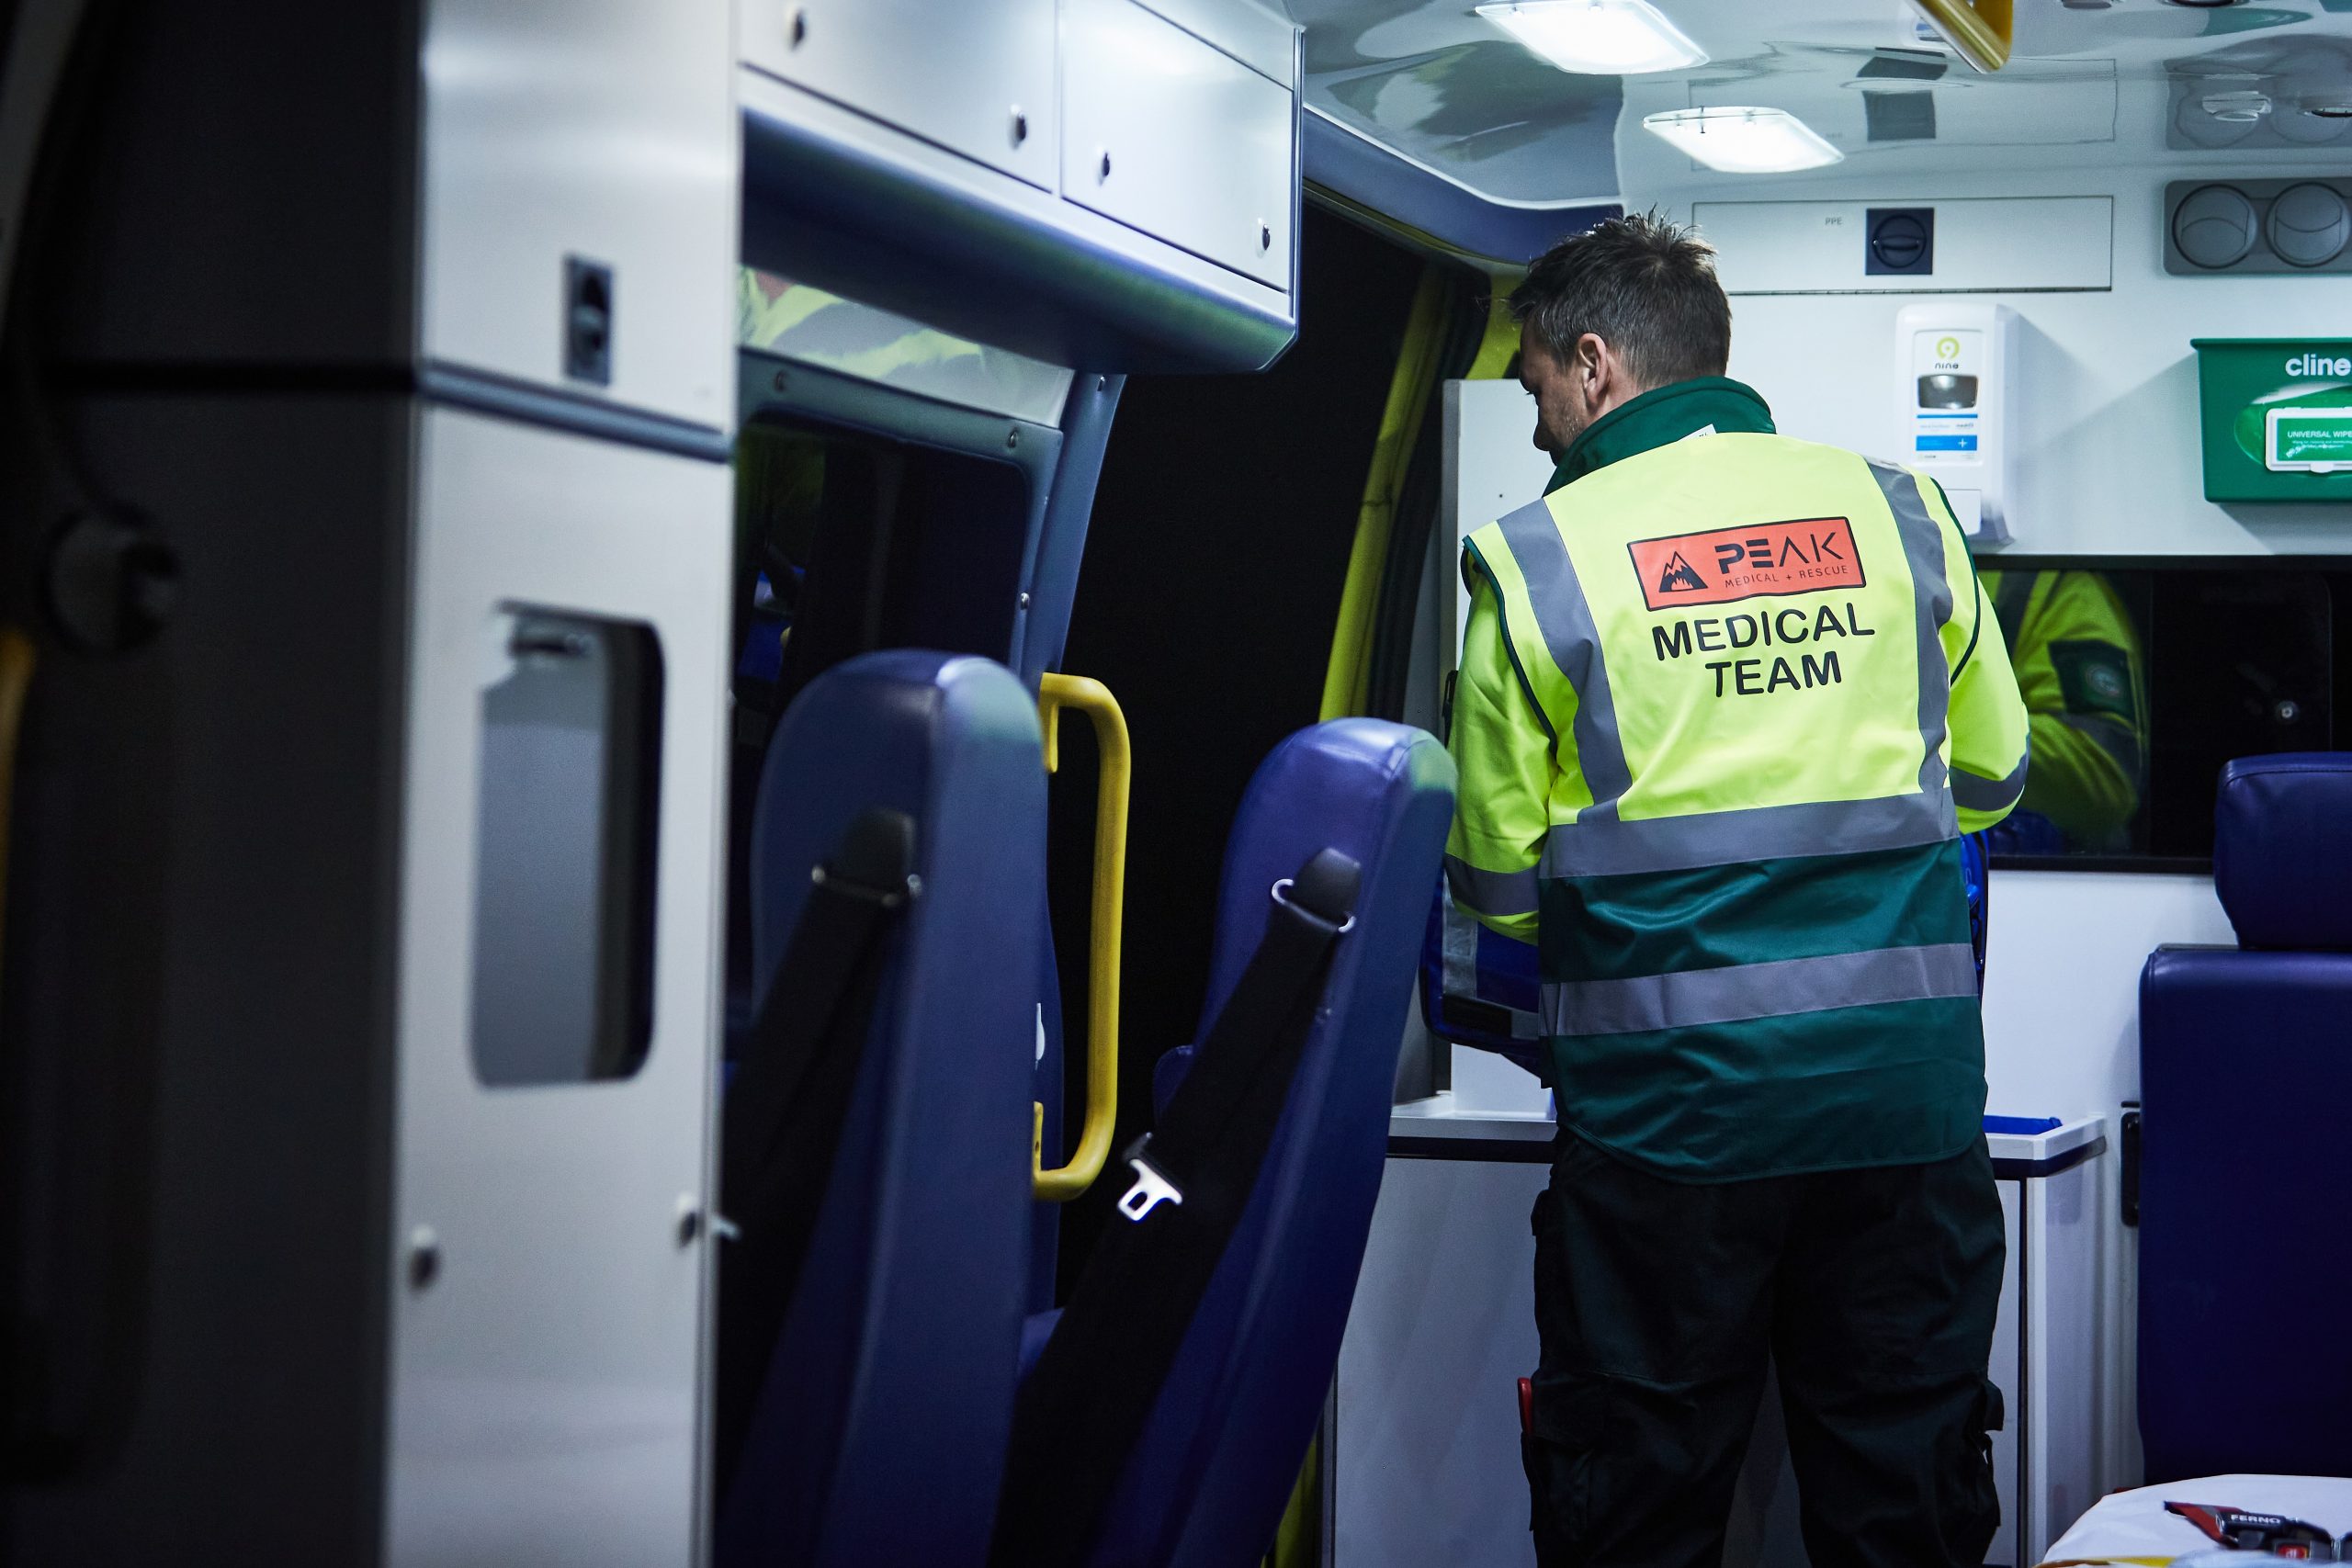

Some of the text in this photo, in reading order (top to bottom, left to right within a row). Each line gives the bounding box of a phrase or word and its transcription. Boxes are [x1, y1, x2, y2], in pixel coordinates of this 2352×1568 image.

[1825, 217, 1842, 226] PPE
[2285, 354, 2351, 377] cline
[1714, 531, 1844, 575] PEAK
[1724, 573, 1780, 589] MEDICAL
[1799, 565, 1849, 579] RESCUE
[1651, 602, 1875, 660] MEDICAL
[1704, 650, 1842, 698] TEAM
[2231, 1514, 2281, 1524] FERNO
